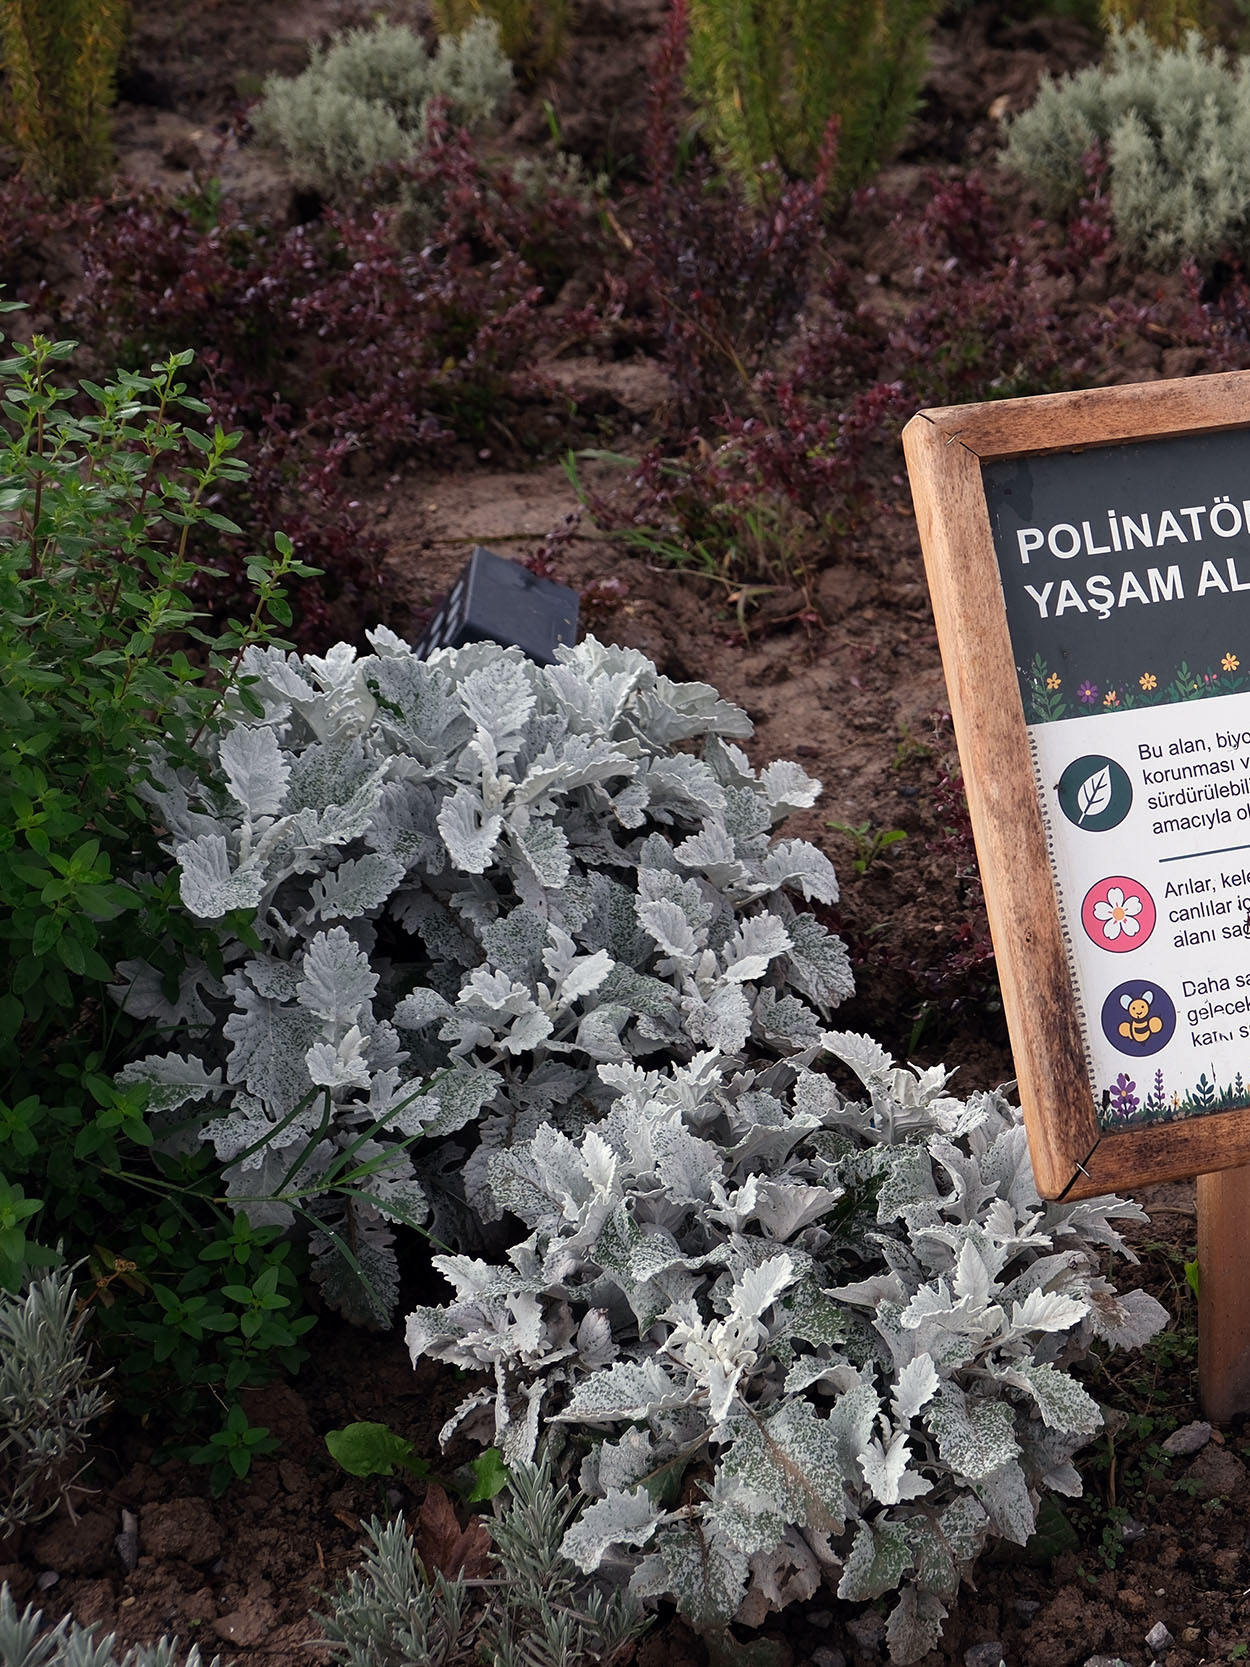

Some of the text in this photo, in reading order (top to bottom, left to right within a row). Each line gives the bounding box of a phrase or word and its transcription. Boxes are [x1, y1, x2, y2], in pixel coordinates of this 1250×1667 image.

[1024, 564, 1184, 619] YAŞAM
[1138, 744, 1163, 760] Bu
[1168, 739, 1211, 756] alan,
[1143, 760, 1235, 785] korunması
[1152, 808, 1232, 834] amacıyla
[1165, 878, 1216, 898] Arılar,
[1169, 900, 1232, 923] canlılar
[1174, 929, 1216, 948] alanı
[1182, 977, 1230, 997] Daha
